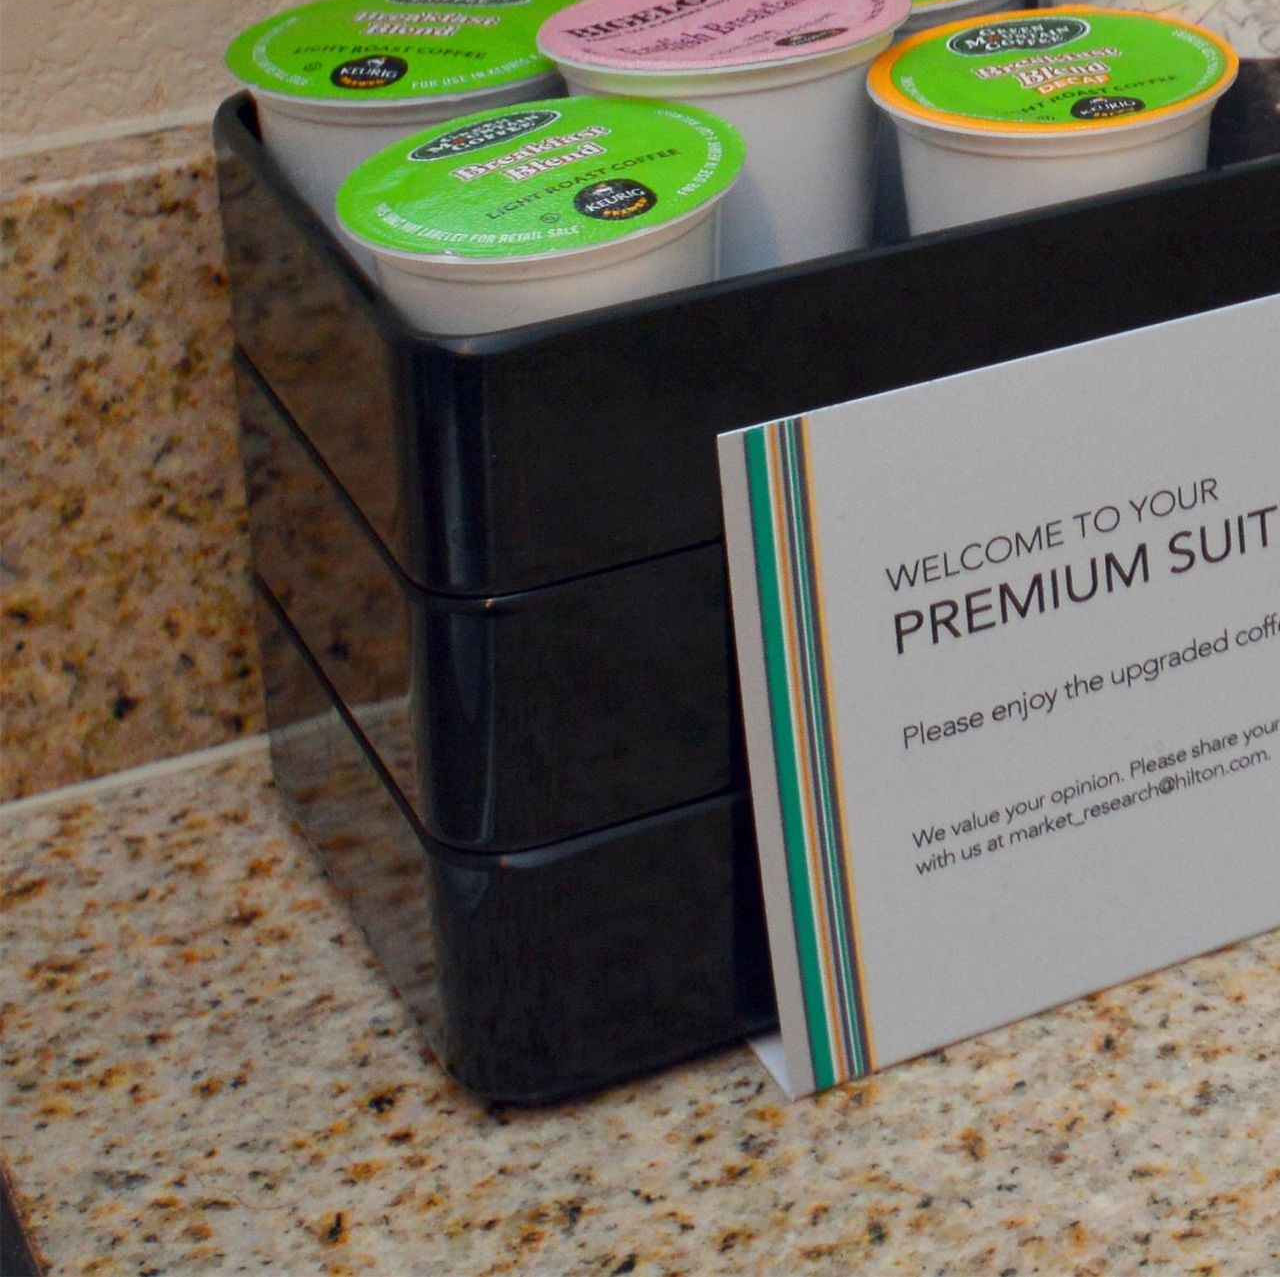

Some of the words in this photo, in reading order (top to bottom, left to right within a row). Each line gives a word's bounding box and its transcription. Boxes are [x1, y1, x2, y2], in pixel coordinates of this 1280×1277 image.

[338, 65, 398, 79] KEURIG
[1013, 61, 1111, 89] Blend
[1036, 74, 1110, 96] DECAF
[450, 126, 612, 182] Breakfast
[501, 135, 608, 182] Blend
[486, 191, 543, 220] LIGHT
[545, 167, 608, 194] ROAST
[611, 148, 681, 171] COFFEE
[585, 188, 646, 213] KEURIG
[469, 233, 497, 245] FOR
[498, 229, 544, 245] RETAIL
[547, 224, 581, 238] SALE
[885, 519, 1065, 592] WELCOME
[1072, 505, 1121, 539] TO
[1129, 477, 1219, 523] YOUR
[894, 542, 1150, 655] PREMIUM
[902, 711, 985, 750] Please
[991, 687, 1059, 721] enjoy
[1064, 674, 1104, 700] the
[1111, 628, 1230, 688] upgraded
[912, 827, 946, 849] We
[951, 809, 1001, 837] value
[1004, 794, 1046, 824] your
[1050, 770, 1125, 805] opinion.
[1129, 746, 1188, 778] Please
[1191, 731, 1239, 760] share
[915, 850, 956, 876] with
[960, 842, 983, 862] us
[987, 834, 1005, 852] at
[1009, 750, 1272, 846] market_research@hilton.com.
